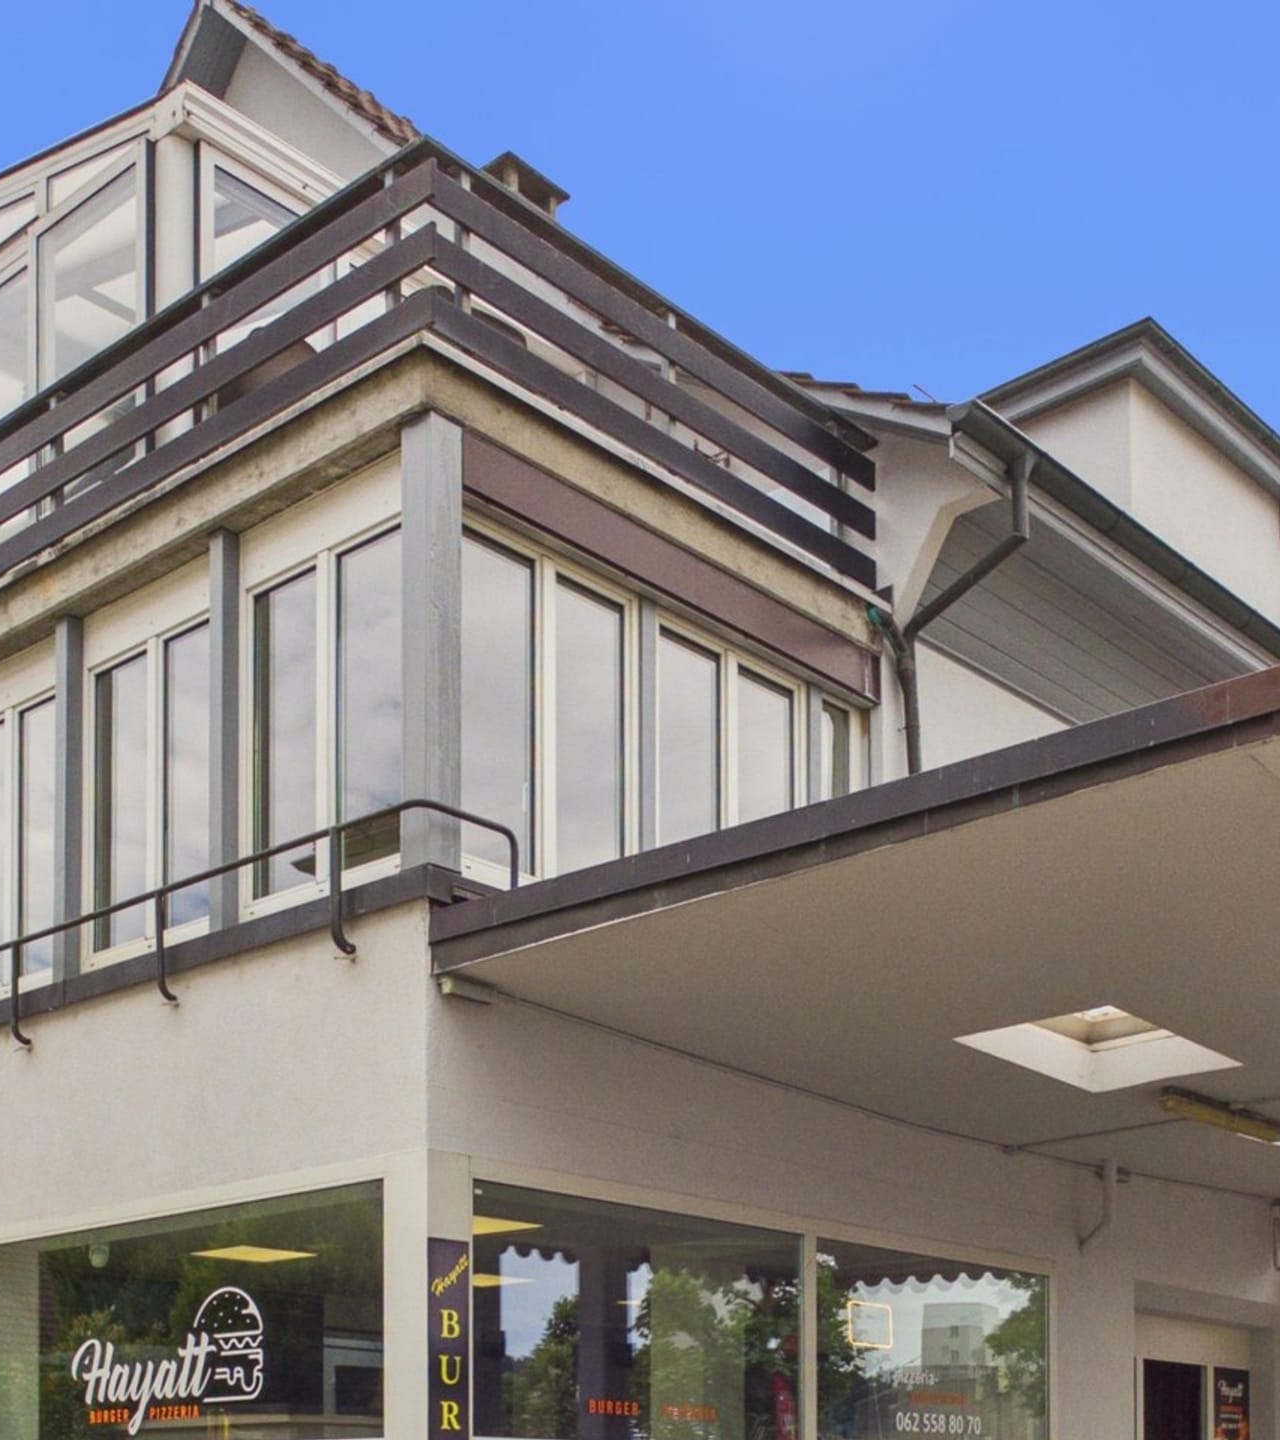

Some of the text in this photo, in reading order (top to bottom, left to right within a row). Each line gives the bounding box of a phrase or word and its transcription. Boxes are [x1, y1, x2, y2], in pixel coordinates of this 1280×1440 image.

[71, 1331, 217, 1436] Hayatt
[88, 1404, 201, 1424] BURGER PIZZERIA
[588, 1399, 639, 1416] BURGER
[895, 1411, 982, 1435] 062 558 80 70
